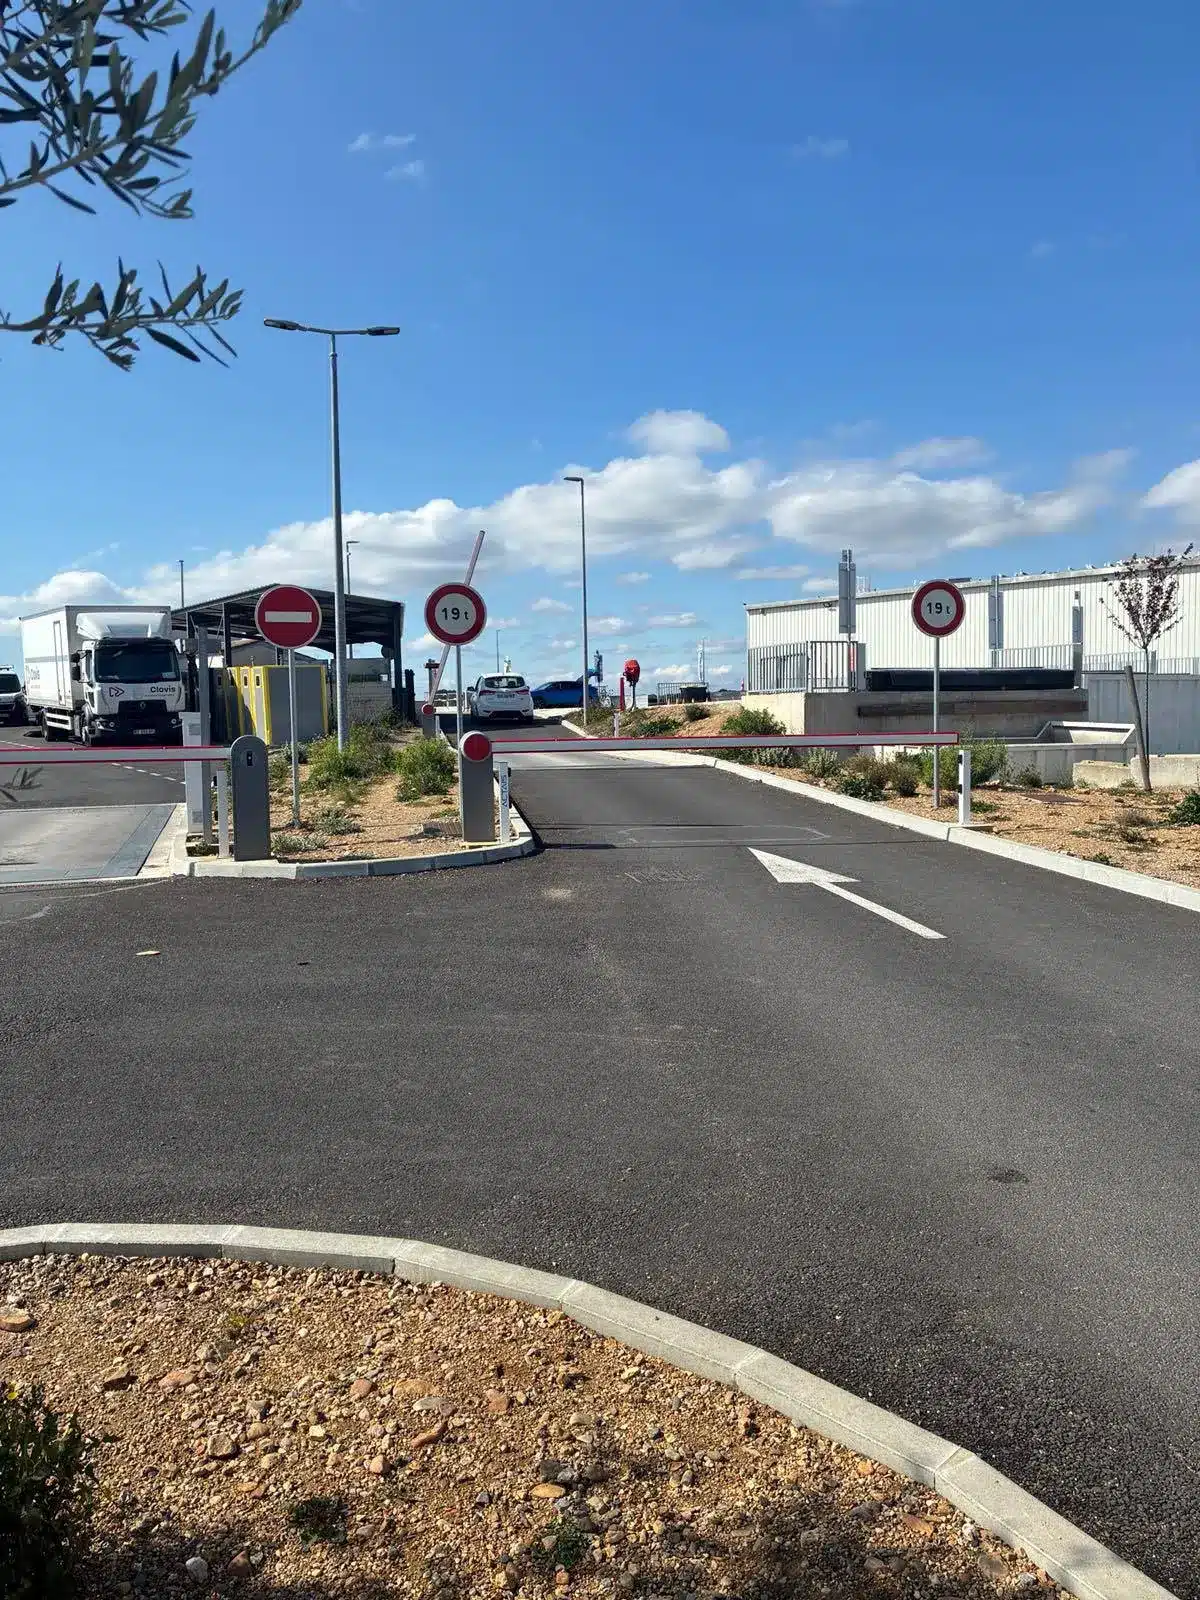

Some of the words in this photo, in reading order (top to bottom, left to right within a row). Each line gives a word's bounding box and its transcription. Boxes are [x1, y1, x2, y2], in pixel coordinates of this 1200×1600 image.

[441, 607, 460, 620] 19
[926, 602, 943, 615] 19
[150, 685, 176, 693] Clovis
